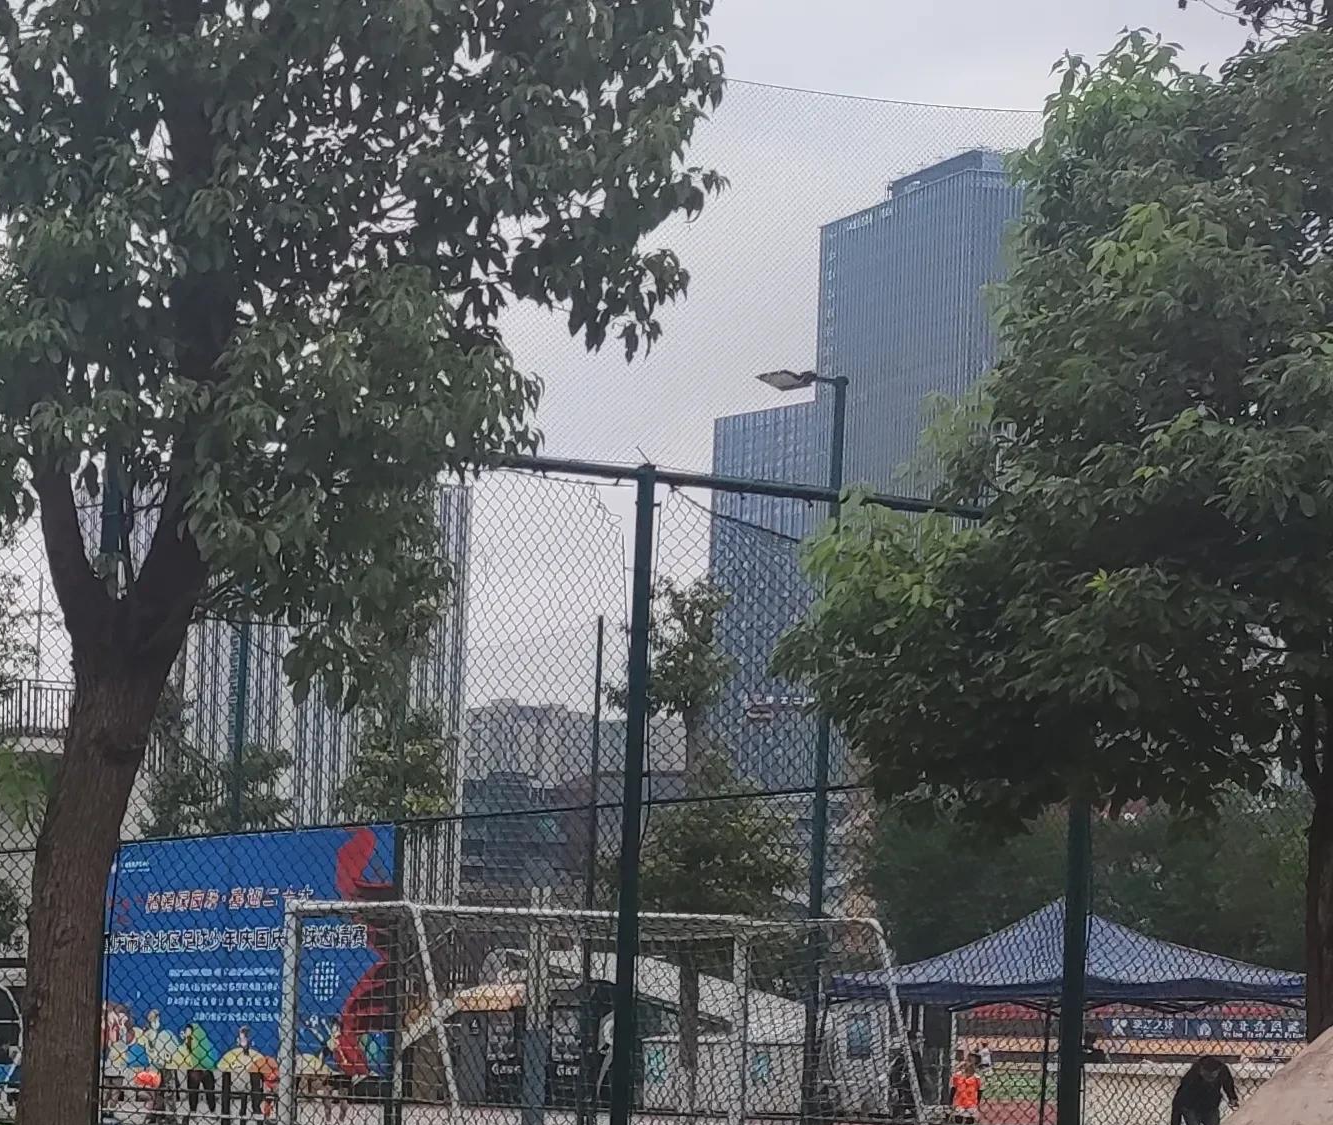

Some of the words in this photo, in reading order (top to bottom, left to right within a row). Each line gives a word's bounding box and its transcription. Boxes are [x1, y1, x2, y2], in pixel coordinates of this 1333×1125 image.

[104, 925, 367, 954] 庆市渝北区足球少年庆国庆球邀请赛
